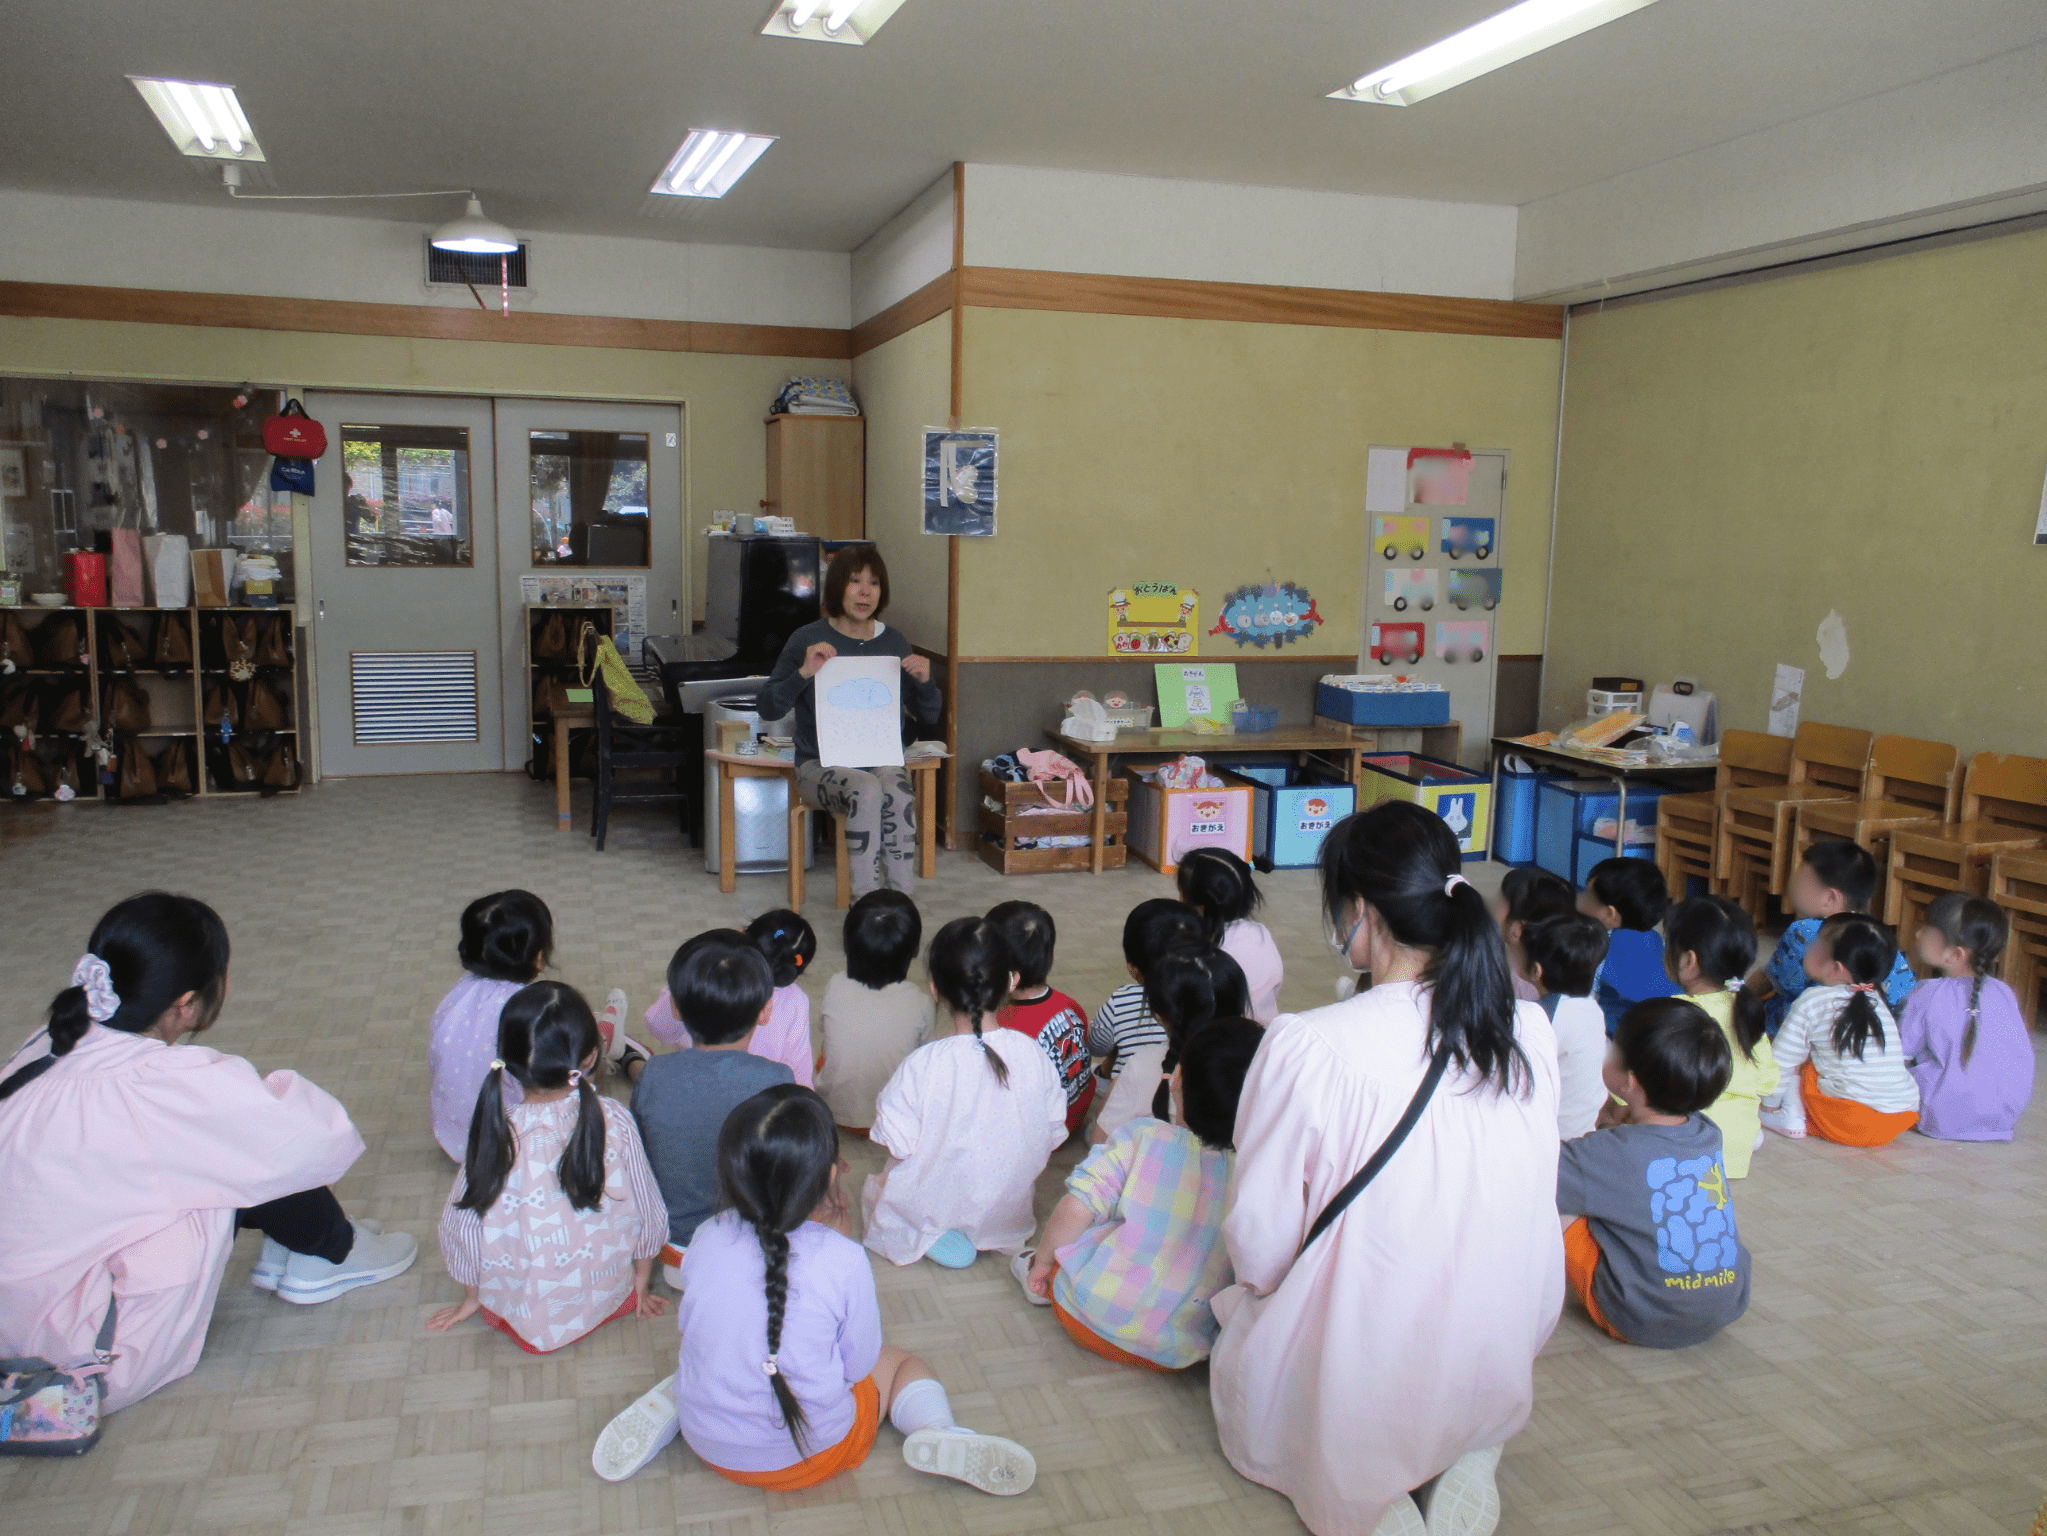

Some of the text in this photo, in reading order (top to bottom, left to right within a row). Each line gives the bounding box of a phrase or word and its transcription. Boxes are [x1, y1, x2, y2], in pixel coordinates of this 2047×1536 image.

[1134, 583, 1177, 596] おとうばん
[1191, 823, 1225, 833] おきがえ
[1300, 820, 1331, 830] おきがえ
[1035, 1011, 1071, 1054] STON
